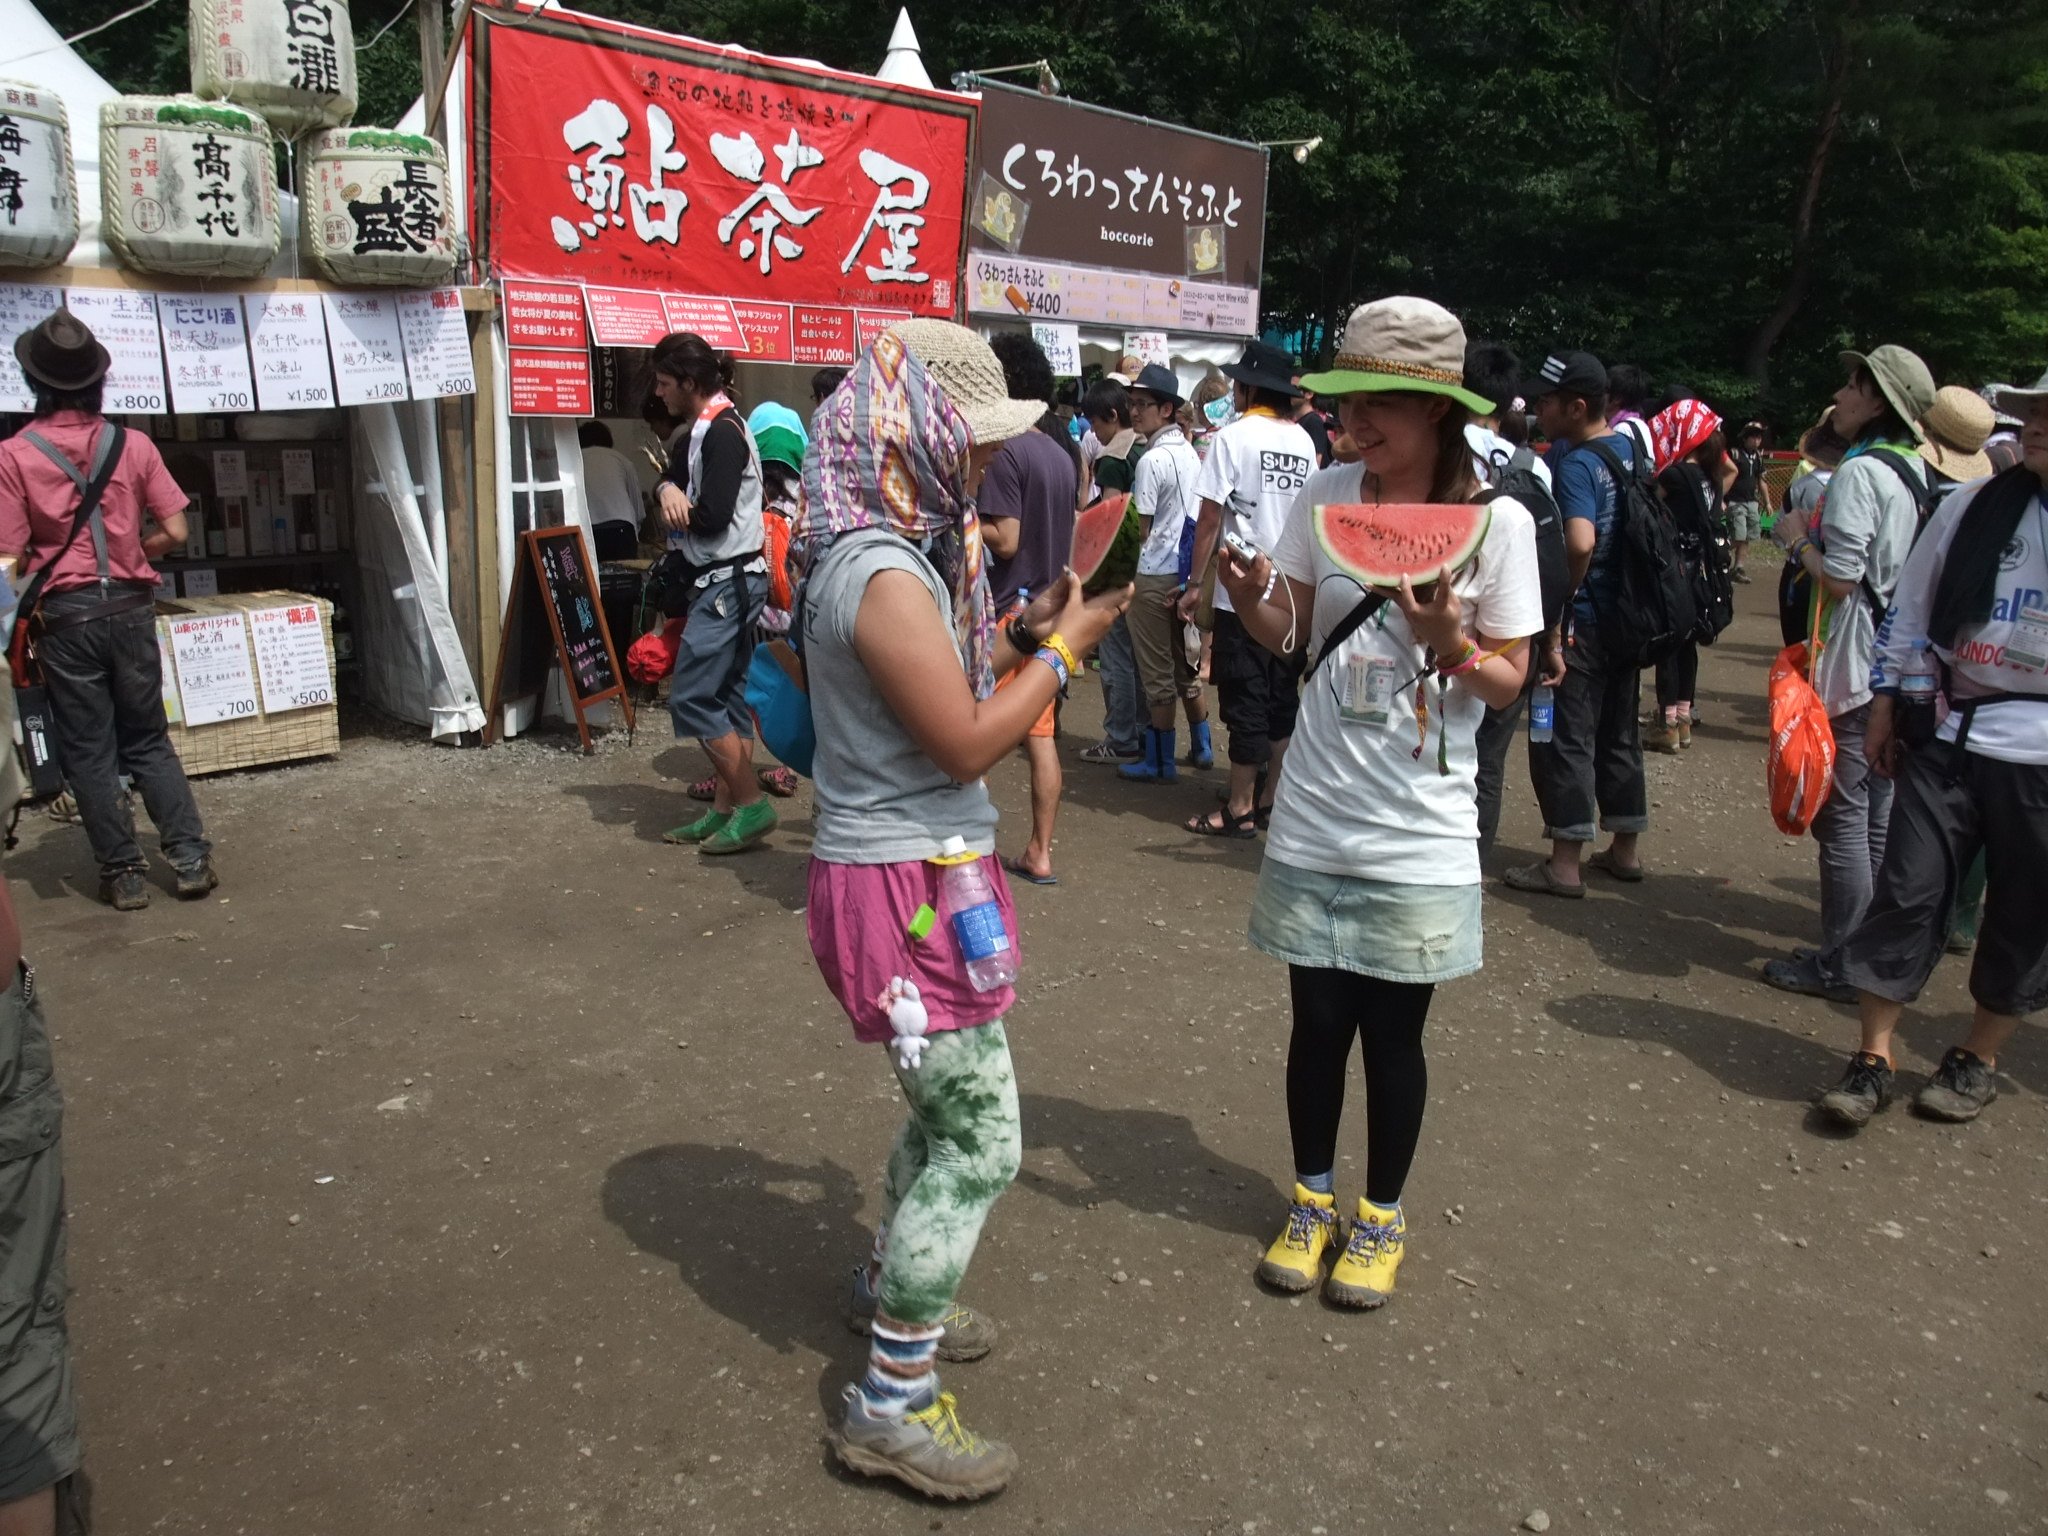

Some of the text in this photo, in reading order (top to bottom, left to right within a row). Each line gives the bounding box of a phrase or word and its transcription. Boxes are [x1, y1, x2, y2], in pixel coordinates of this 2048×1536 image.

[550, 98, 930, 283] 鮎茶屋
[1002, 143, 1242, 228] くろわっさんそふと
[1100, 226, 1154, 247] hoccorie
[1026, 291, 1061, 315] ¥400
[263, 360, 302, 374] 八海山
[287, 387, 328, 402] ¥1,500
[366, 382, 403, 399] ¥1,200
[437, 378, 472, 394] ¥500
[113, 395, 161, 409] ¥800
[208, 392, 248, 408] ¥700
[290, 688, 328, 705] ¥500
[217, 699, 255, 717] ¥700
